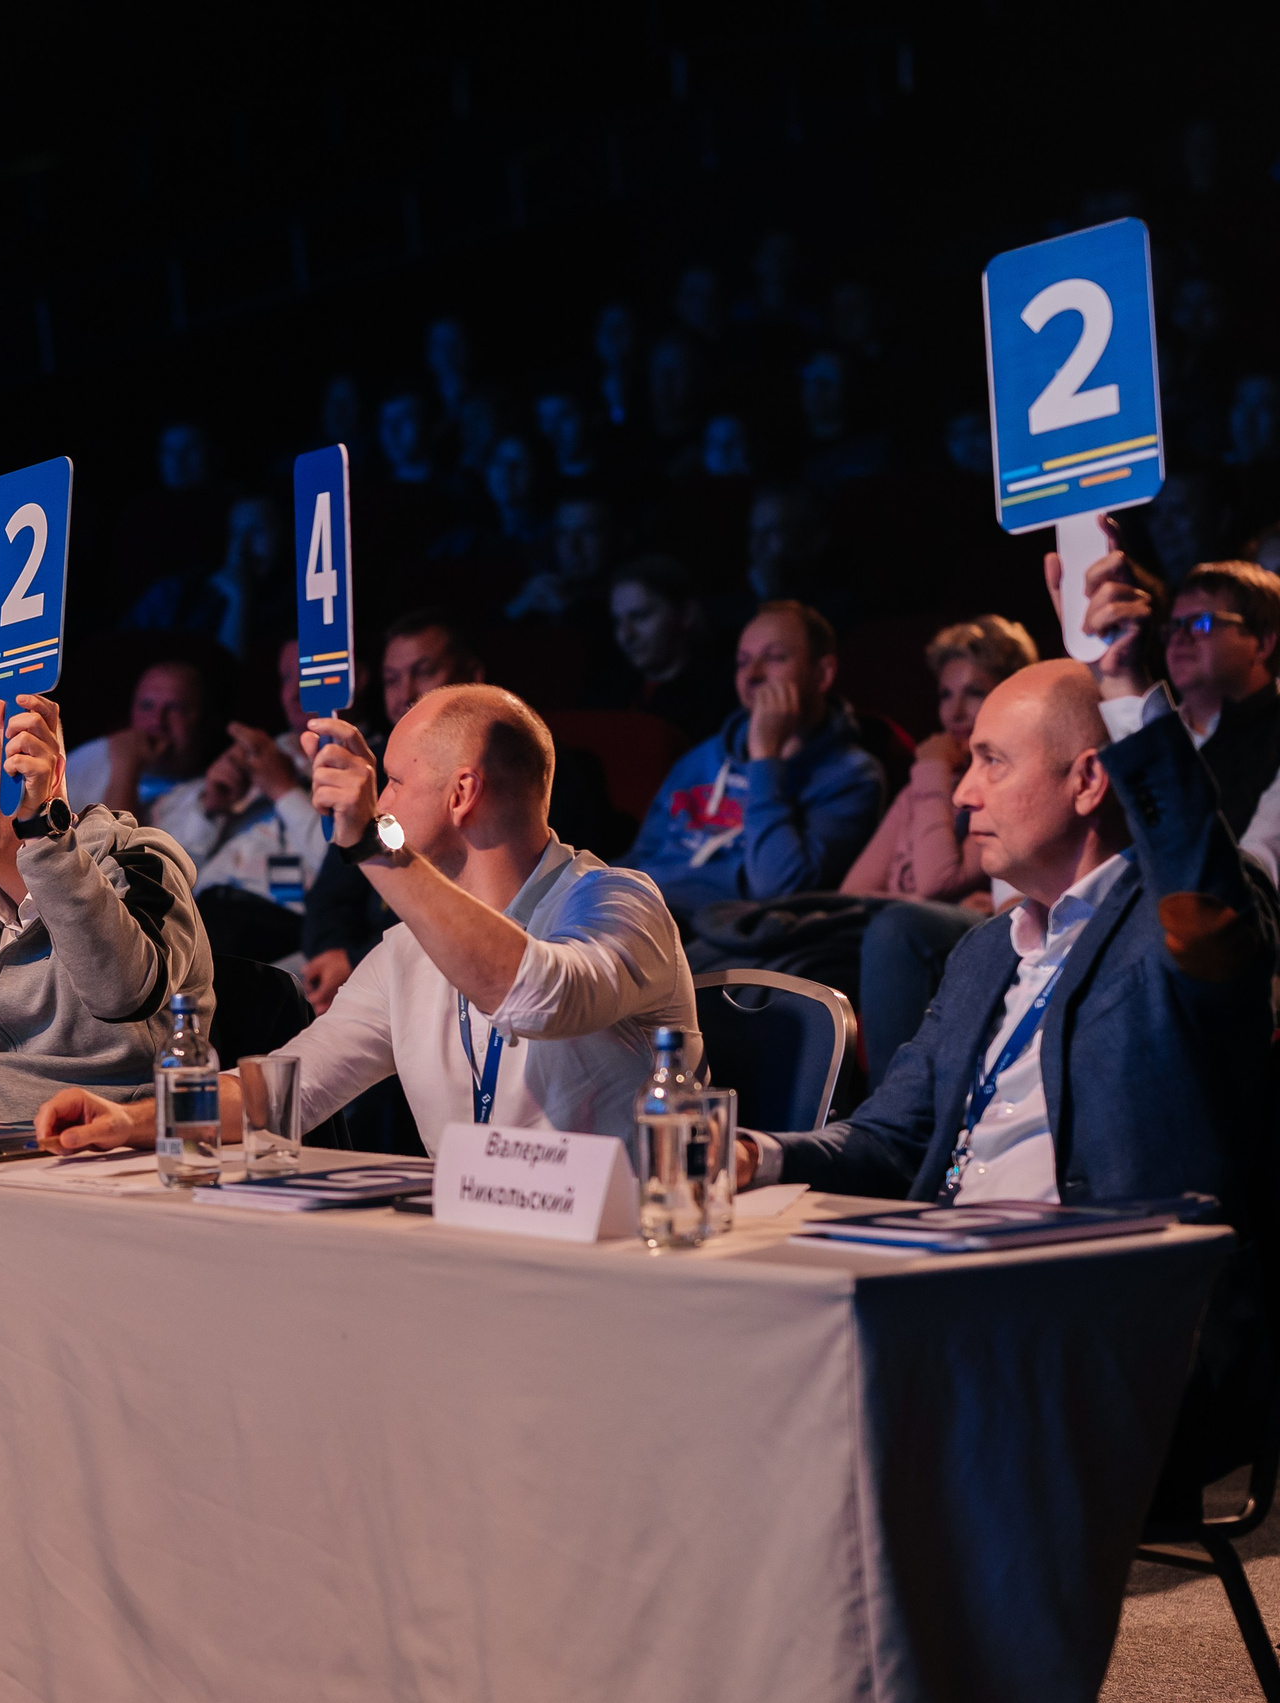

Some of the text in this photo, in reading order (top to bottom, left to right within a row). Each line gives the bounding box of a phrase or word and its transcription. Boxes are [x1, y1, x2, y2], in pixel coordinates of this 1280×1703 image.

[1020, 278, 1121, 435] 2
[305, 490, 338, 626] 4
[485, 1131, 569, 1167] Валерий
[459, 1175, 575, 1215] Никольский
